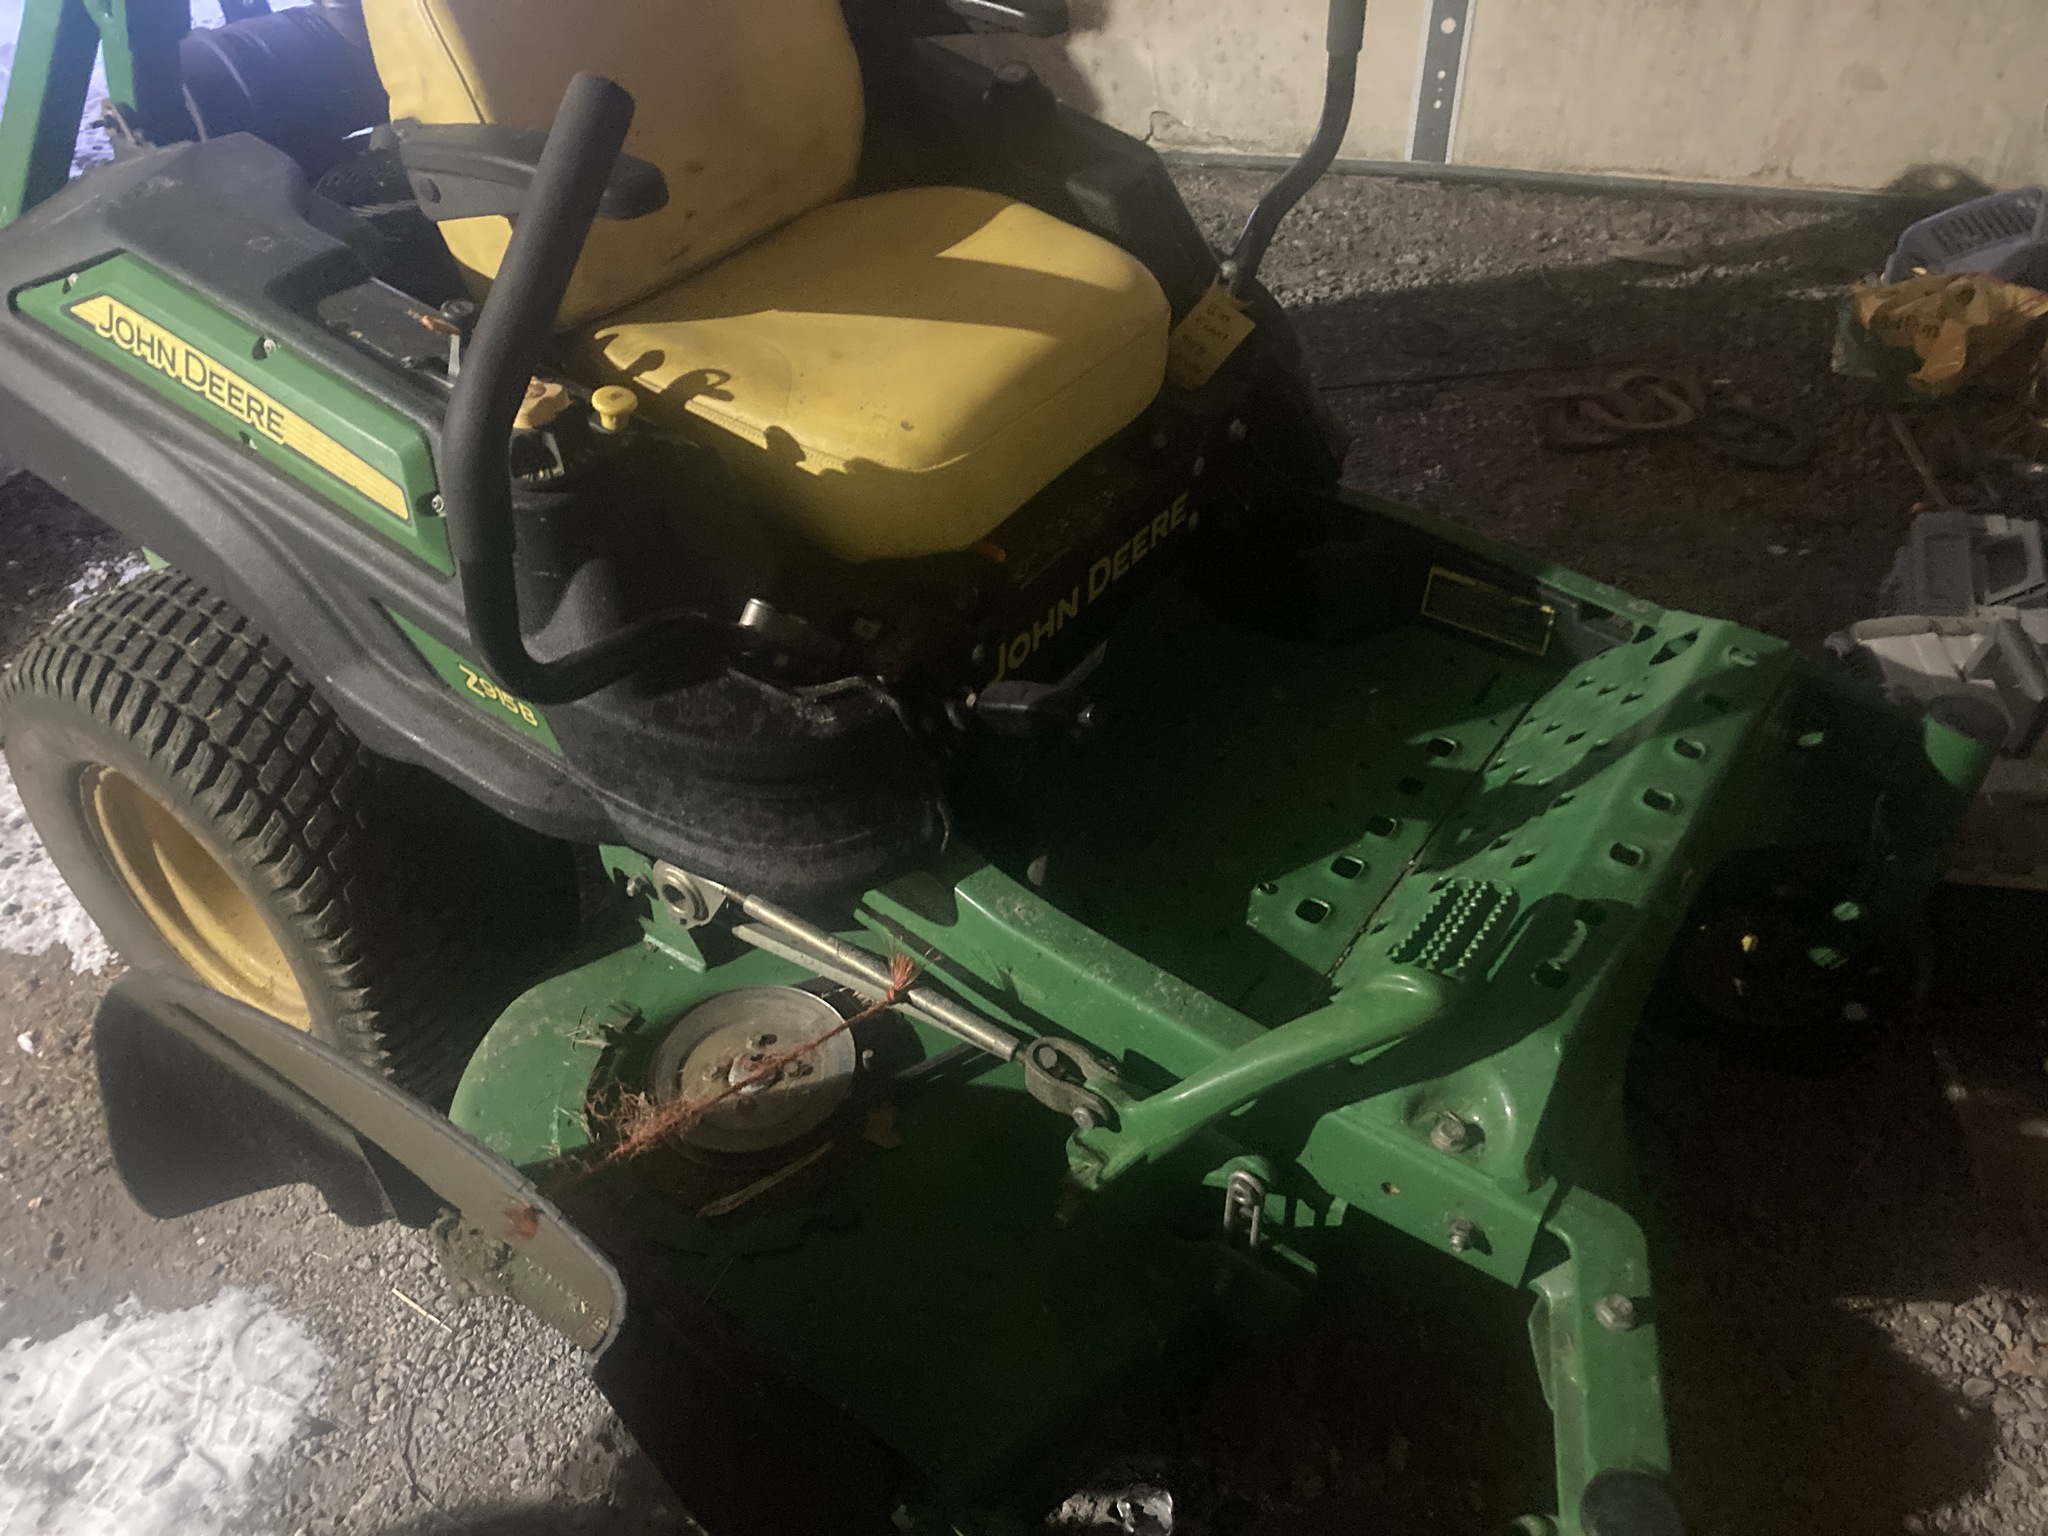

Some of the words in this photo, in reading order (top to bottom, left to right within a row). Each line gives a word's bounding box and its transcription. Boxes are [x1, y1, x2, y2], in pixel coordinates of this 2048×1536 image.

[99, 303, 177, 373] JOHN
[184, 348, 285, 440] DEERE
[989, 586, 1079, 684] JOHN
[1087, 491, 1188, 604] DEERE
